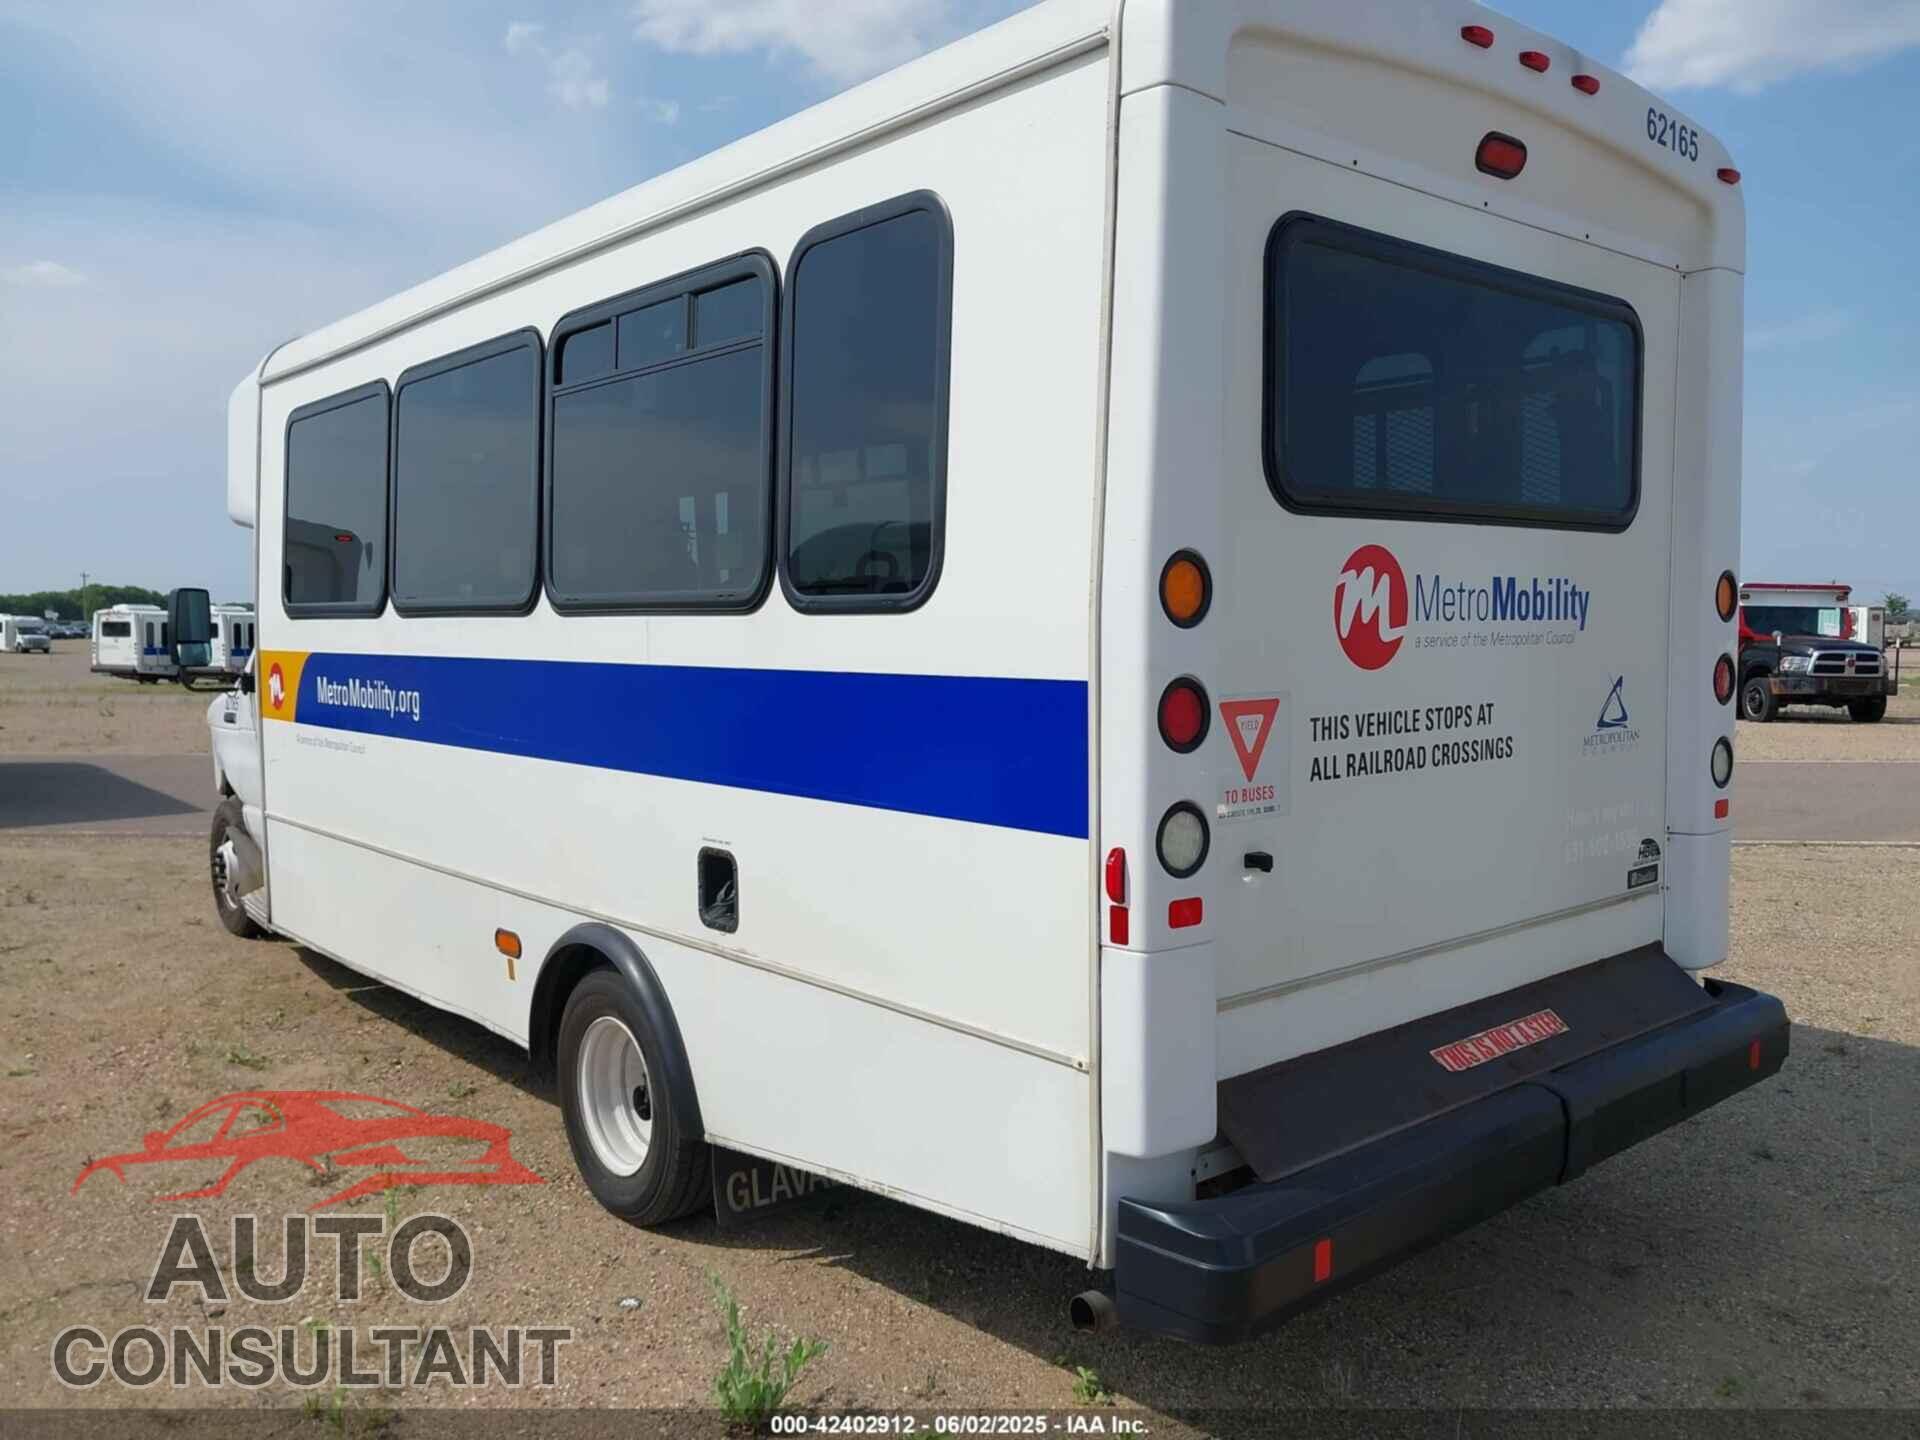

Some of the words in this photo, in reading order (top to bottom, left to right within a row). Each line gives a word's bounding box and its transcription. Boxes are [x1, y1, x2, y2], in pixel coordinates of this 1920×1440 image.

[1647, 106, 1699, 162] 62165
[1414, 574, 1590, 632] MetroMobility
[1423, 634, 1458, 648] service
[1460, 632, 1471, 647] of
[1472, 631, 1488, 647] the
[1491, 631, 1544, 649] Metropolitan
[316, 675, 421, 722] MetroMobility.org
[1310, 714, 1350, 742] THIS
[1355, 708, 1420, 738] VEHICLE
[1425, 704, 1472, 731] STOPS
[1477, 702, 1494, 726] AT
[1310, 754, 1341, 782] ALL
[1346, 745, 1426, 777] RAILROAD
[1432, 736, 1513, 767] CROSSINGS
[1224, 789, 1238, 805] TO
[1241, 785, 1274, 803] BUSES
